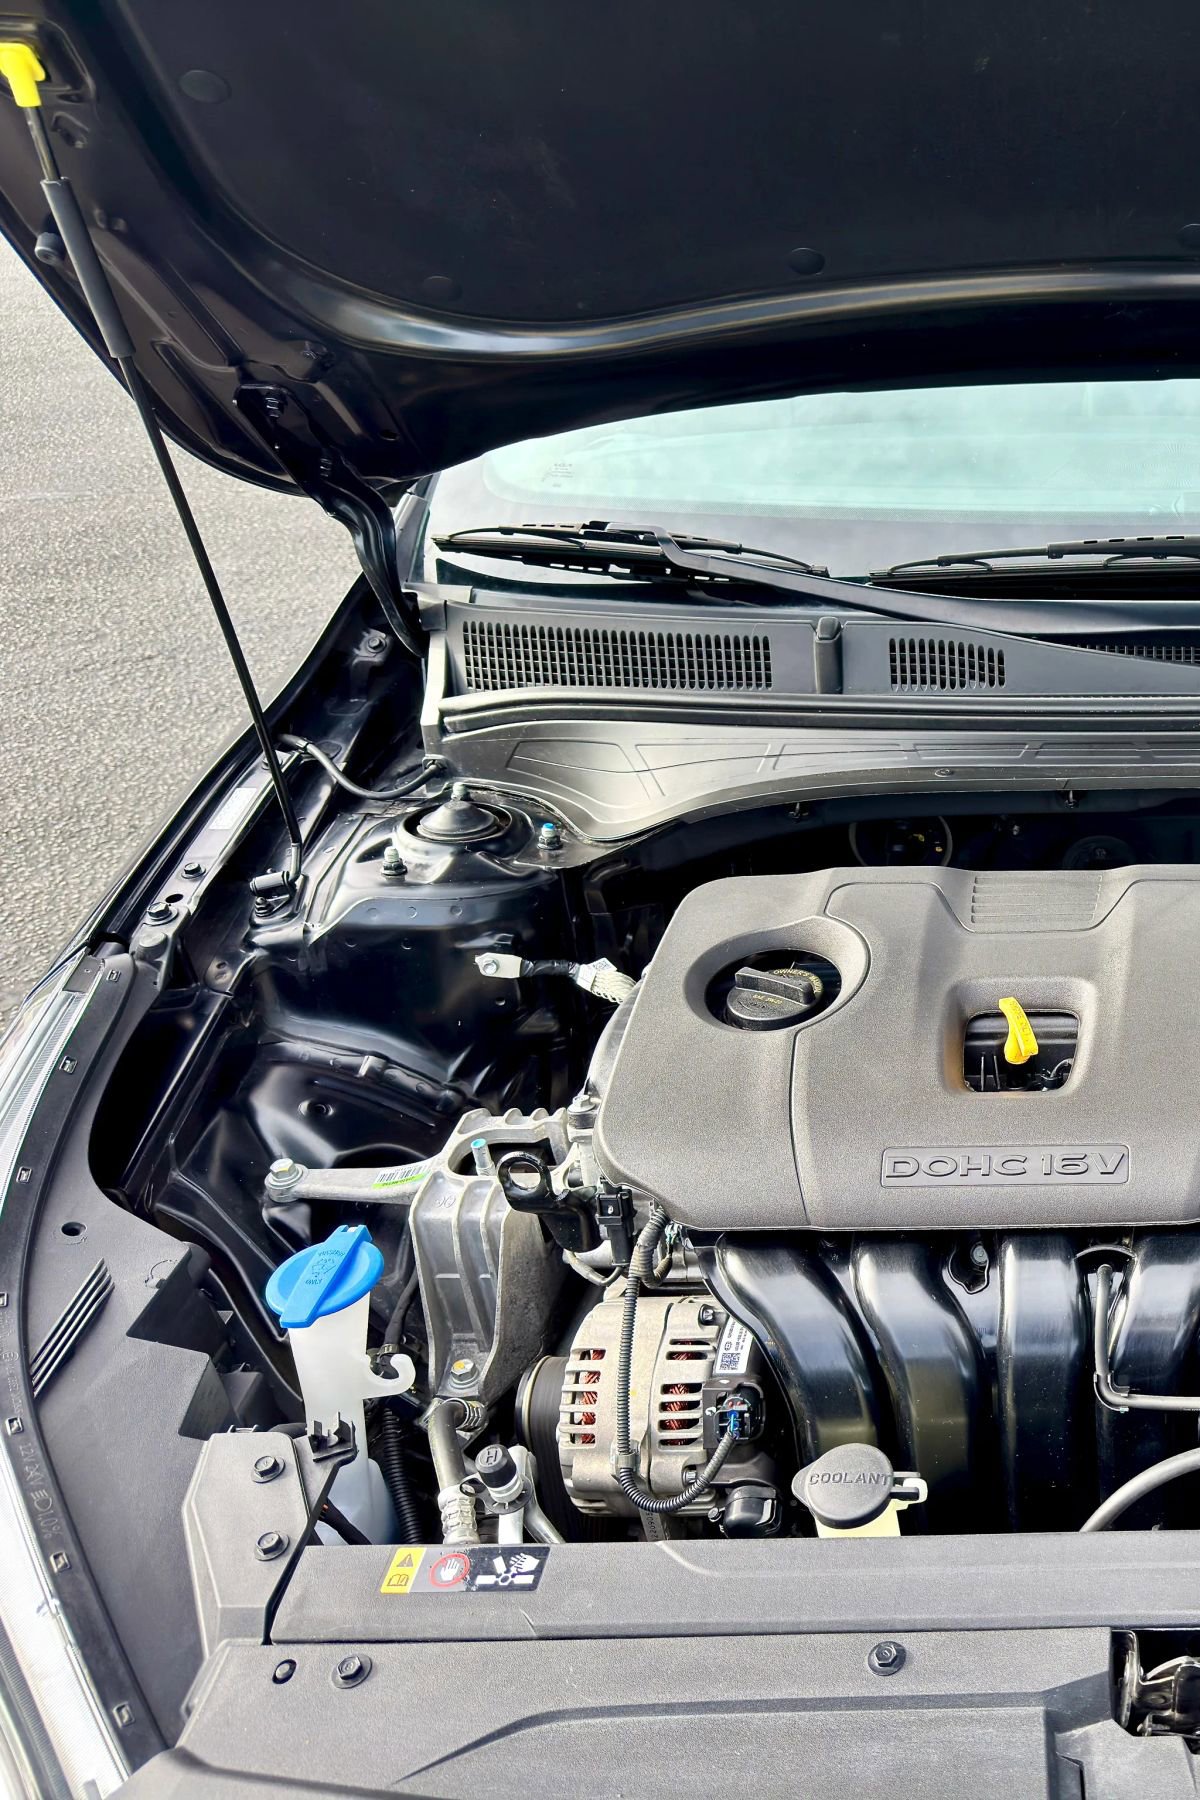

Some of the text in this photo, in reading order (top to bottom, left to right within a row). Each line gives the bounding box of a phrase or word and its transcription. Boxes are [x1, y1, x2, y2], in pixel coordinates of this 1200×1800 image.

[885, 1152, 1126, 1178] DOHC 16V
[808, 1471, 893, 1486] COOLANT
